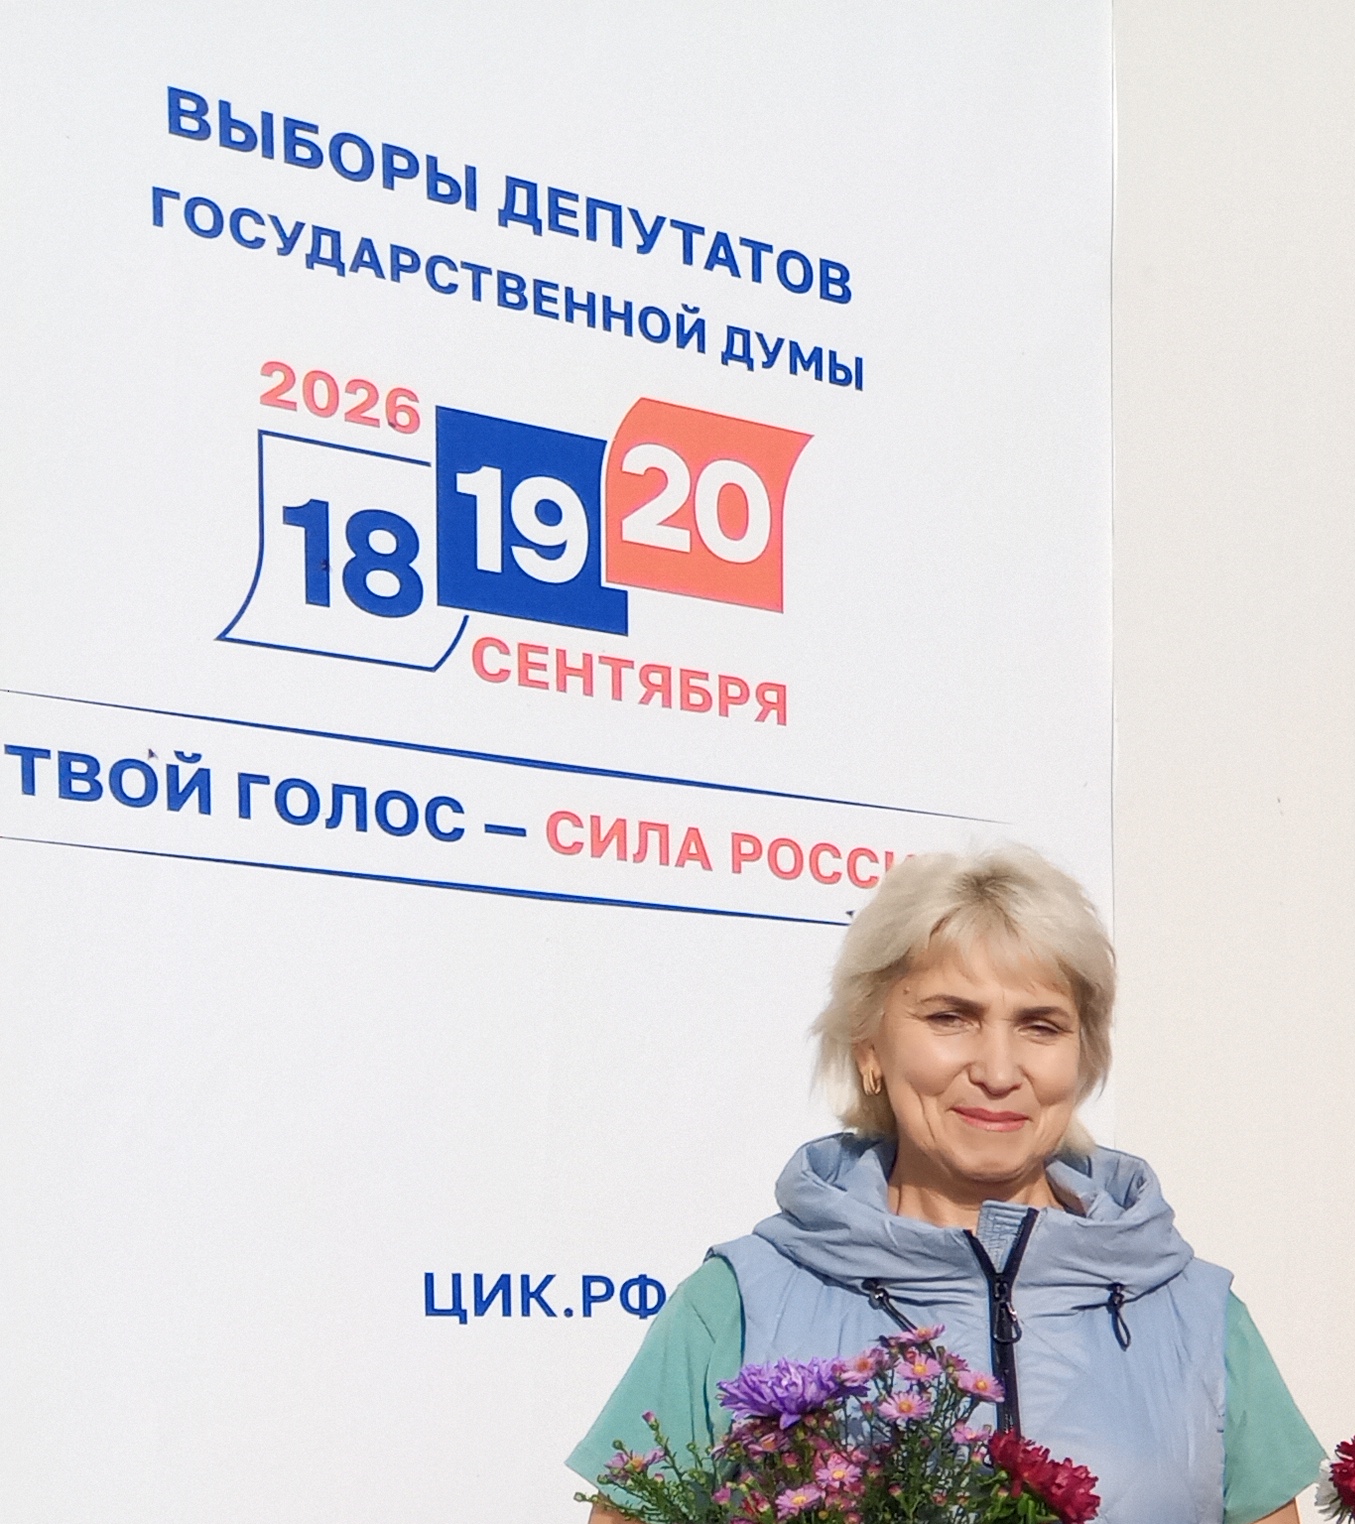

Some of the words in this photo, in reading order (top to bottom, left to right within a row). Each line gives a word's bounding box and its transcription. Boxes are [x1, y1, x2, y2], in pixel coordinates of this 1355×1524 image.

[167, 86, 478, 213] ВЫБОРЫ
[498, 173, 853, 306] ДЕПУТАТОВ
[150, 186, 707, 353] ГОСУДАРСТВЕННОЙ
[720, 326, 863, 392] ДУМЫ
[258, 361, 422, 435] 2026
[282, 498, 424, 619] 18
[455, 467, 590, 584] 19
[619, 443, 771, 565] 20
[471, 637, 788, 726] СЕНТЯБРЯ
[3, 743, 211, 815] ТВОЙ
[237, 773, 465, 842] ГОЛОС
[546, 809, 712, 870] СИЛА
[731, 832, 893, 889] РОСС
[424, 1272, 666, 1325] ЦИК.РФ
